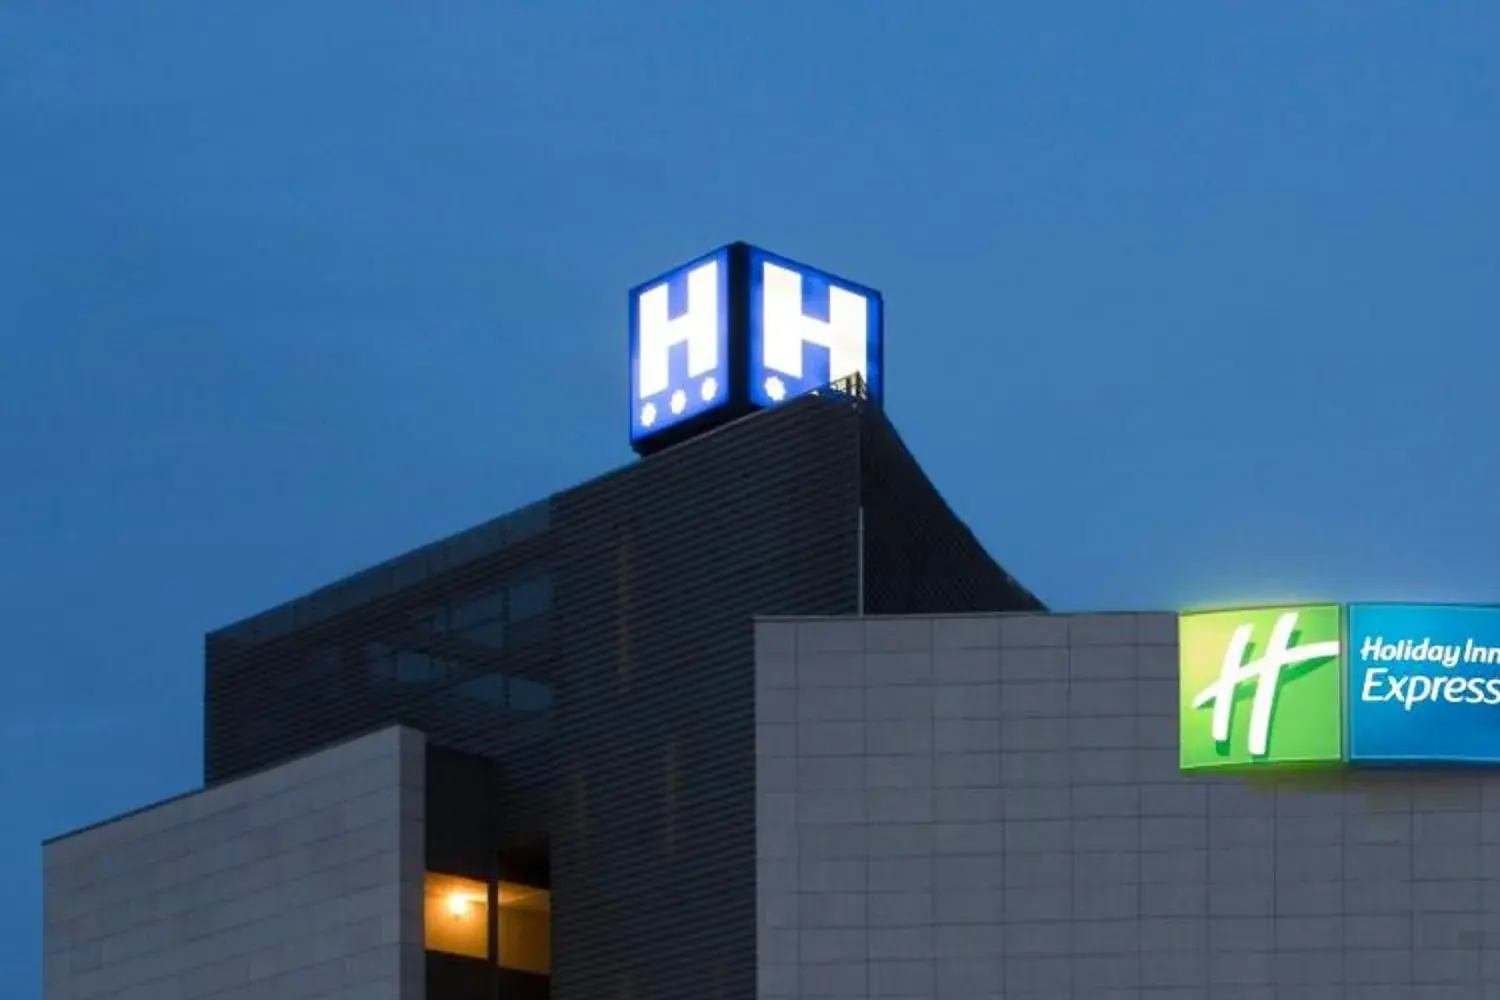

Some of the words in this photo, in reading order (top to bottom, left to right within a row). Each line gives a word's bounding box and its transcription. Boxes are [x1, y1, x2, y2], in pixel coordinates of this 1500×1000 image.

[639, 259, 718, 399] H
[763, 260, 868, 399] H
[1360, 635, 1460, 668] Holiday
